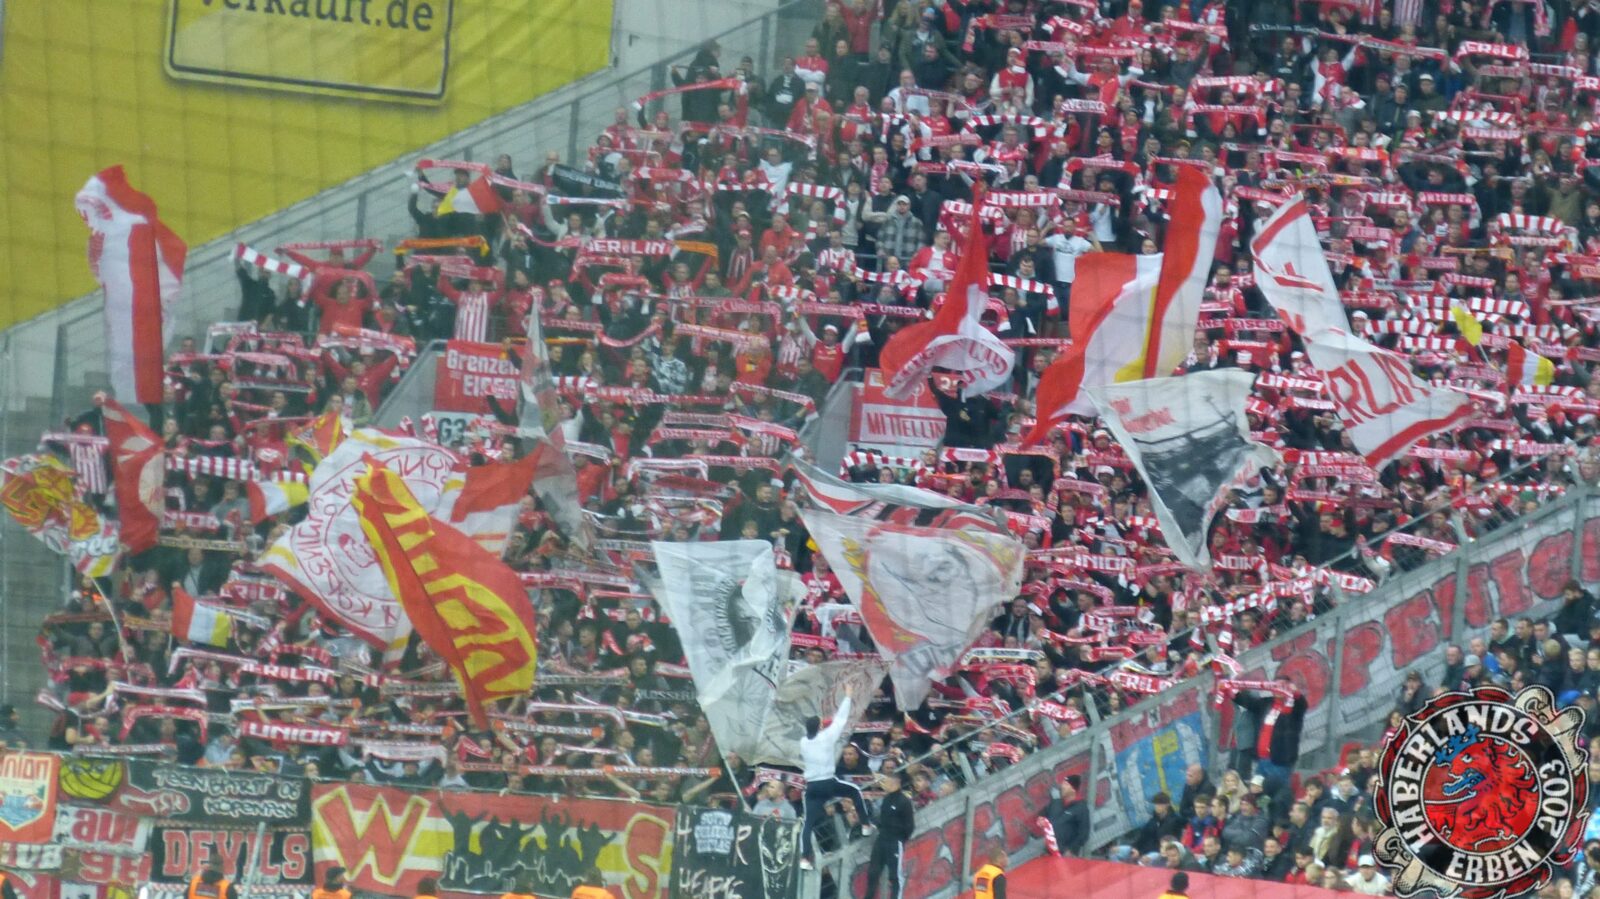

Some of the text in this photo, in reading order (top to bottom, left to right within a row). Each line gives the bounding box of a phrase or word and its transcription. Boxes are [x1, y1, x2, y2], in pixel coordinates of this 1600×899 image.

[203, 0, 434, 31] auft.de
[1458, 41, 1531, 60] ERLIN
[1257, 374, 1324, 392] UNIO
[250, 722, 341, 744] UNION
[162, 829, 310, 880] DEVILS
